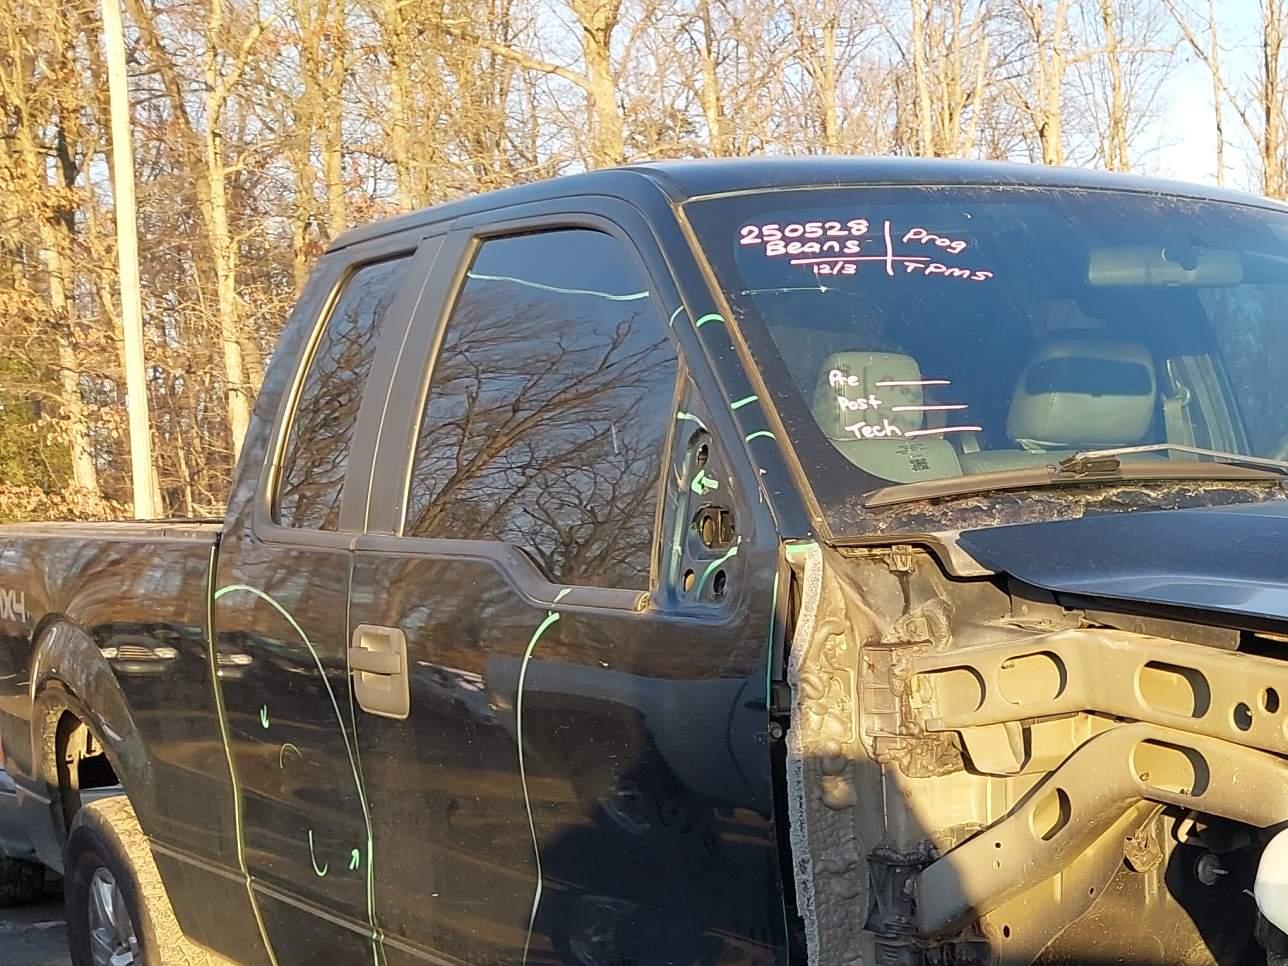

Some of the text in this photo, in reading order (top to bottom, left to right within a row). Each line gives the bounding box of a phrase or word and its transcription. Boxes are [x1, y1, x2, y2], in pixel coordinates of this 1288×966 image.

[739, 218, 869, 245] 250528
[765, 239, 861, 257] Beans
[812, 261, 857, 275] 12/3
[903, 261, 994, 281] TPMS
[828, 369, 860, 388] Pre
[844, 418, 902, 440] Tech
[0, 588, 26, 623] X4
